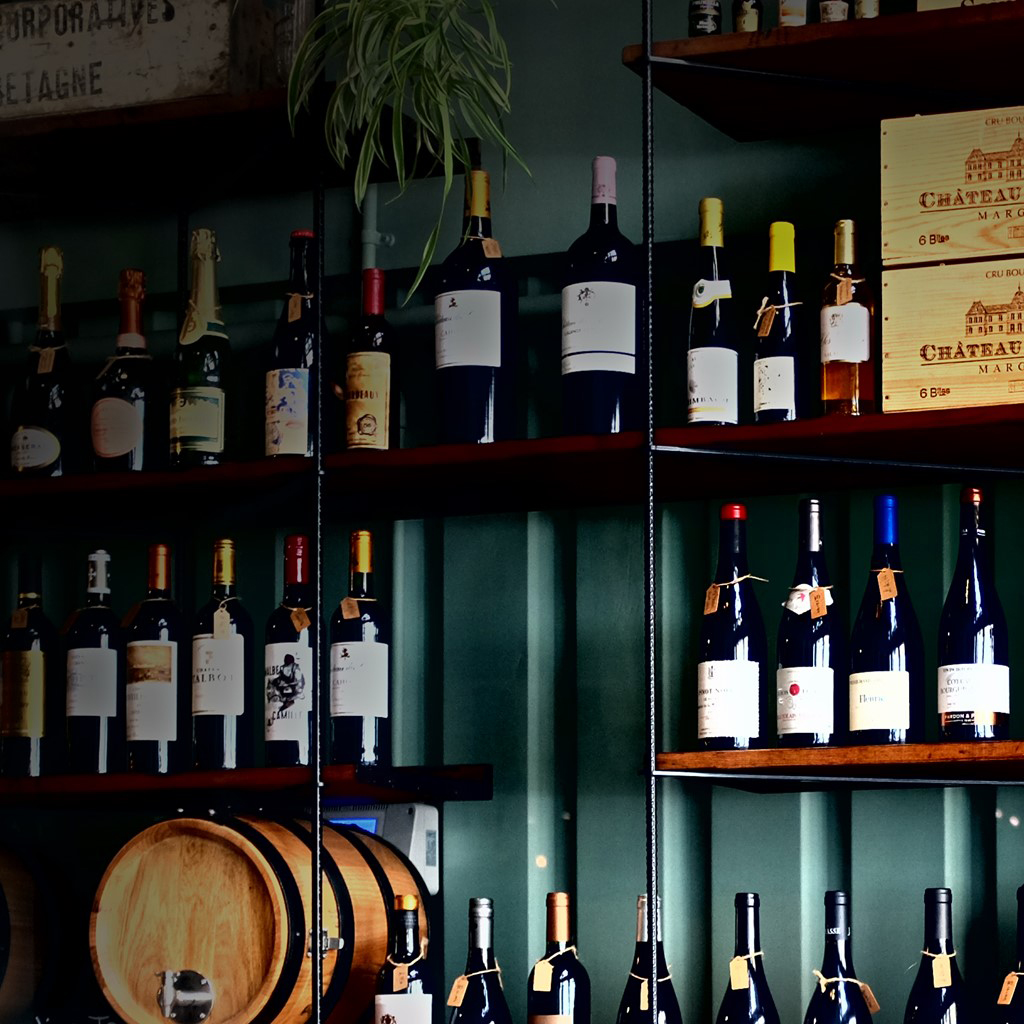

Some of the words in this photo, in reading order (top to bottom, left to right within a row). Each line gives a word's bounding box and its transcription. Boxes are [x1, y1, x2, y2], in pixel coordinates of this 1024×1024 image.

[919, 186, 1023, 210] CHÂTEAU
[918, 235, 927, 246] 6
[985, 270, 1004, 280] CRU
[919, 340, 1023, 362] CHÂTEAU
[919, 388, 928, 399] 6
